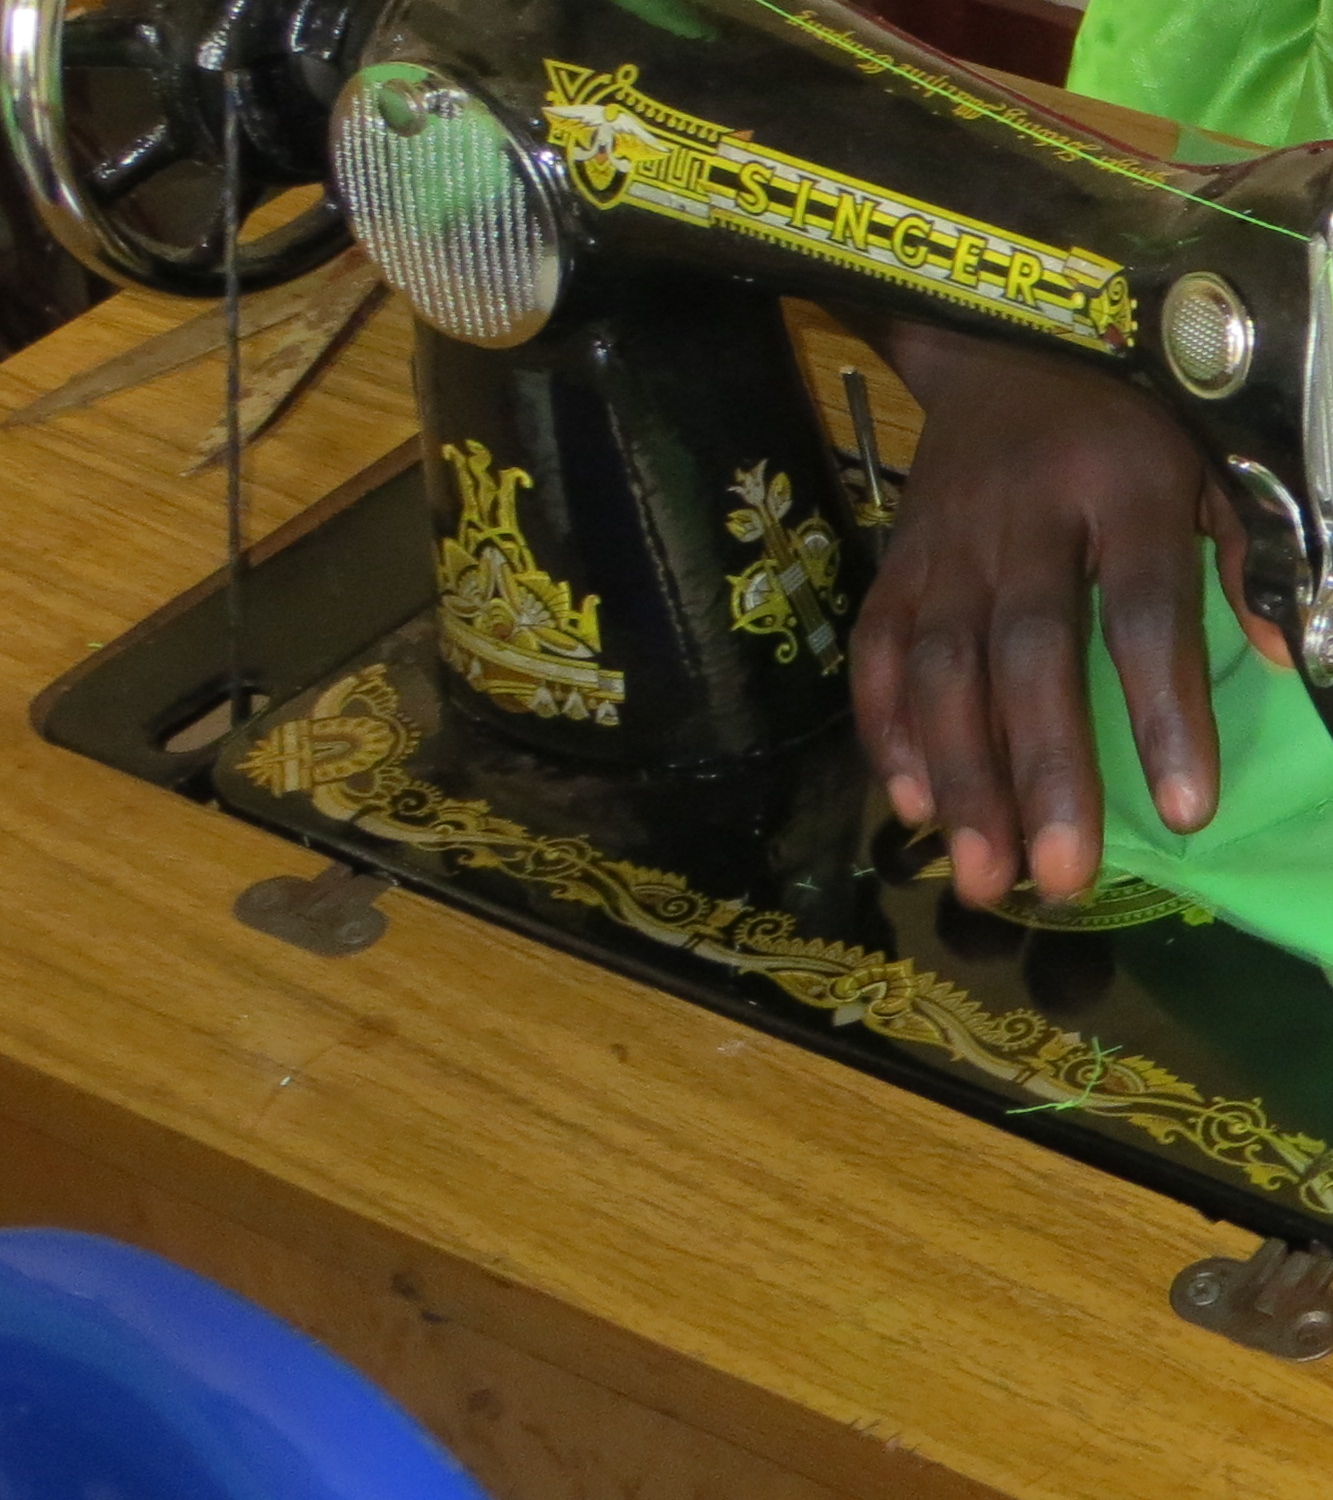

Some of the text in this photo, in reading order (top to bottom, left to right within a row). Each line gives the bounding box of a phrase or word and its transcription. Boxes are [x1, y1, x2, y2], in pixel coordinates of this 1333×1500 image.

[785, 10, 895, 74] Company
[898, 63, 1007, 120] Machine
[1000, 108, 1103, 162] Sewing
[733, 163, 1045, 309] SINGER
